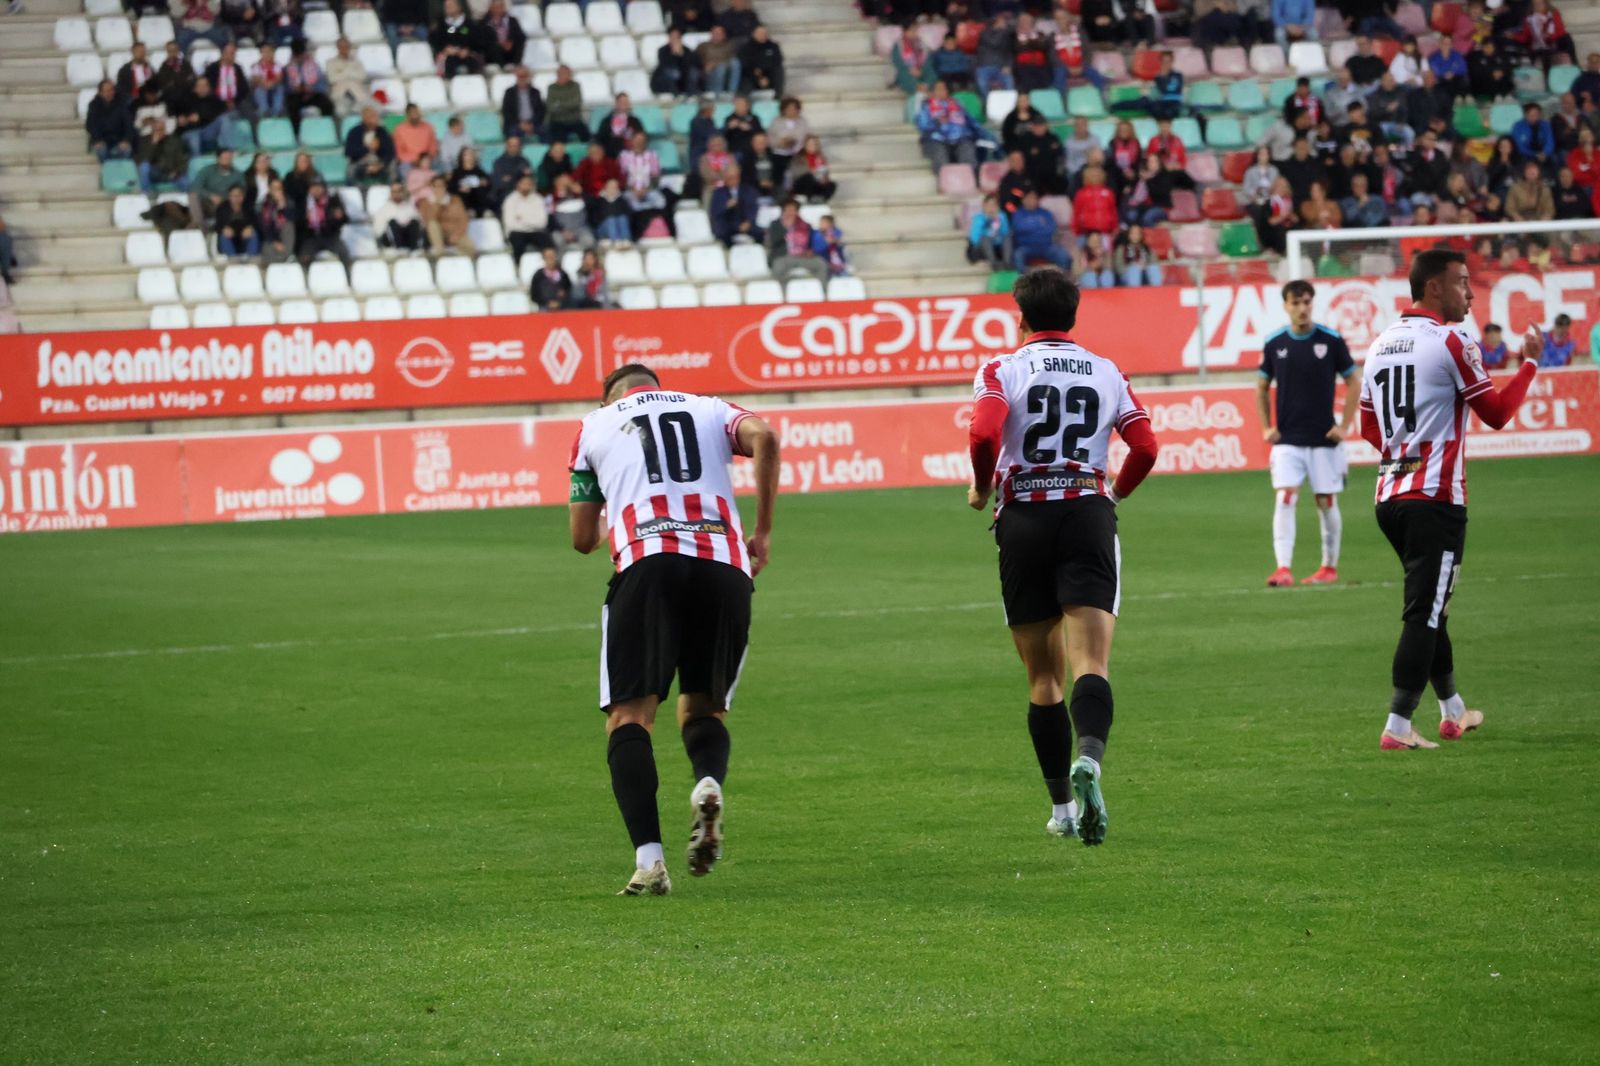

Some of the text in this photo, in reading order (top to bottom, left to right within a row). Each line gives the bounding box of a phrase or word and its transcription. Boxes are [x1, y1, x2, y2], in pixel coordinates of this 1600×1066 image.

[262, 328, 375, 378] Atilano
[760, 358, 892, 379] EMBUTIDOS
[1043, 358, 1093, 375] SANCHO
[1374, 365, 1416, 438] 14
[780, 416, 854, 448] Joven
[1023, 385, 1100, 464] 22
[620, 411, 702, 484] 10
[456, 468, 539, 489] Junta de
[818, 450, 884, 484] León
[215, 482, 326, 515] juventud
[405, 491, 473, 511] Castilla
[492, 487, 541, 507] León
[1011, 476, 1098, 491] leomotor.net
[635, 519, 726, 538] leomotor.net
